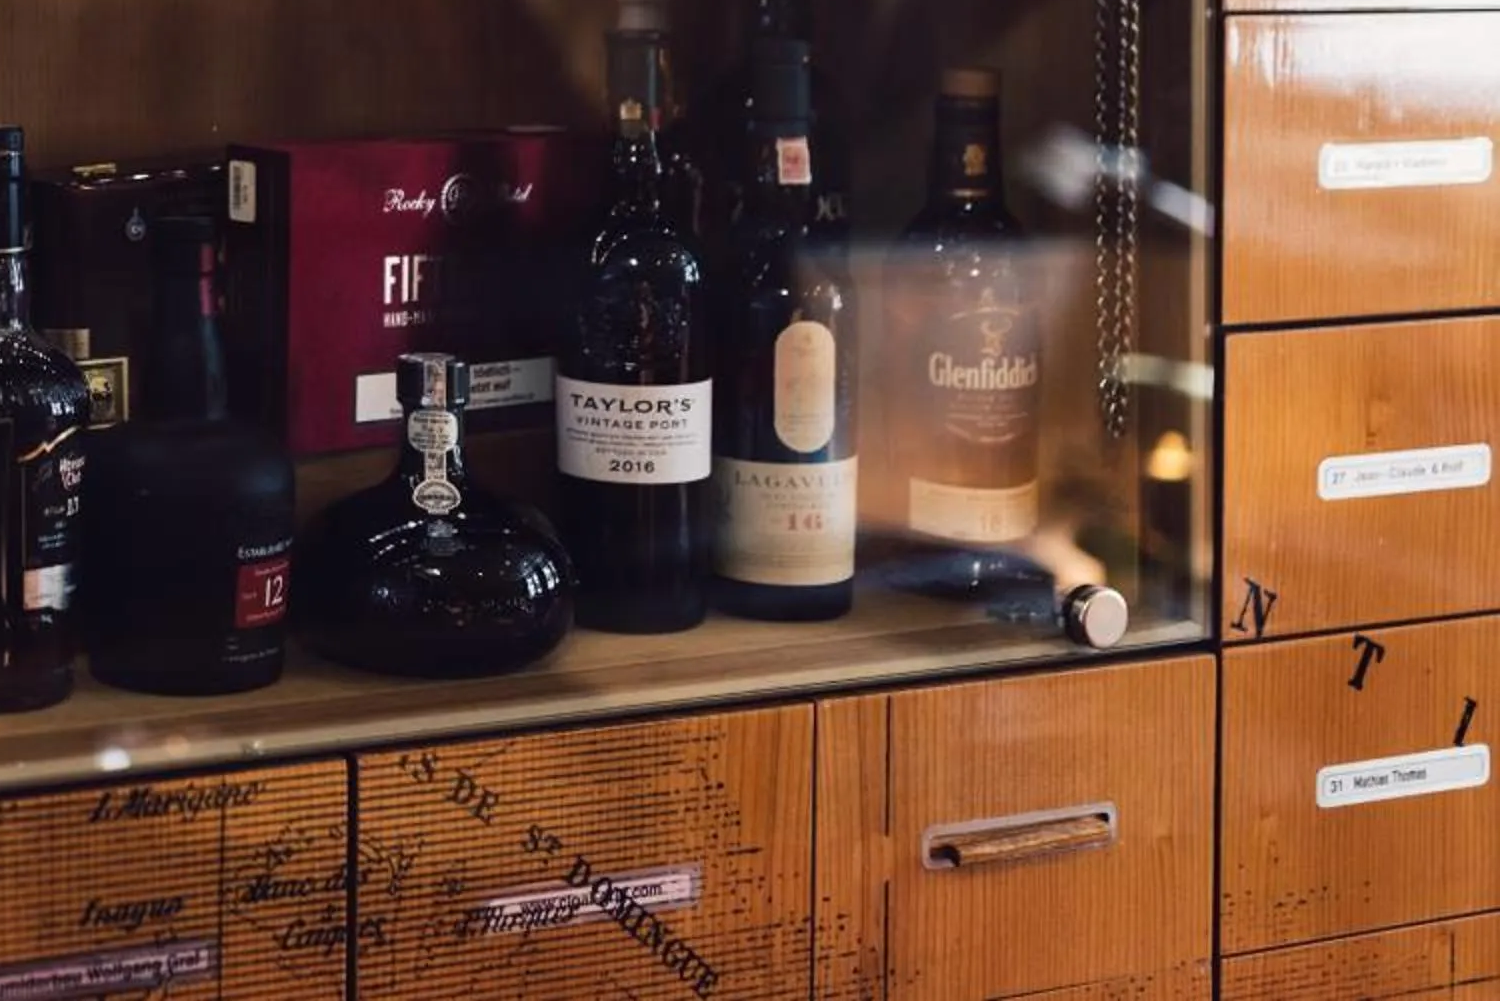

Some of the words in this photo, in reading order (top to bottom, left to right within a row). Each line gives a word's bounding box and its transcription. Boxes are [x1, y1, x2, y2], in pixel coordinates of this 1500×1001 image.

[383, 189, 436, 218] Rocky
[384, 255, 427, 305] FIF
[570, 393, 692, 415] TAYLOR'S
[577, 415, 644, 430] VINTAGE
[649, 417, 688, 430] PORT
[608, 459, 655, 474] 2016
[787, 511, 823, 532] 16
[263, 574, 284, 607] 12
[1230, 577, 1278, 639] N
[1347, 633, 1386, 692] T
[1329, 780, 1344, 794] 31
[1391, 767, 1427, 784] Thomas
